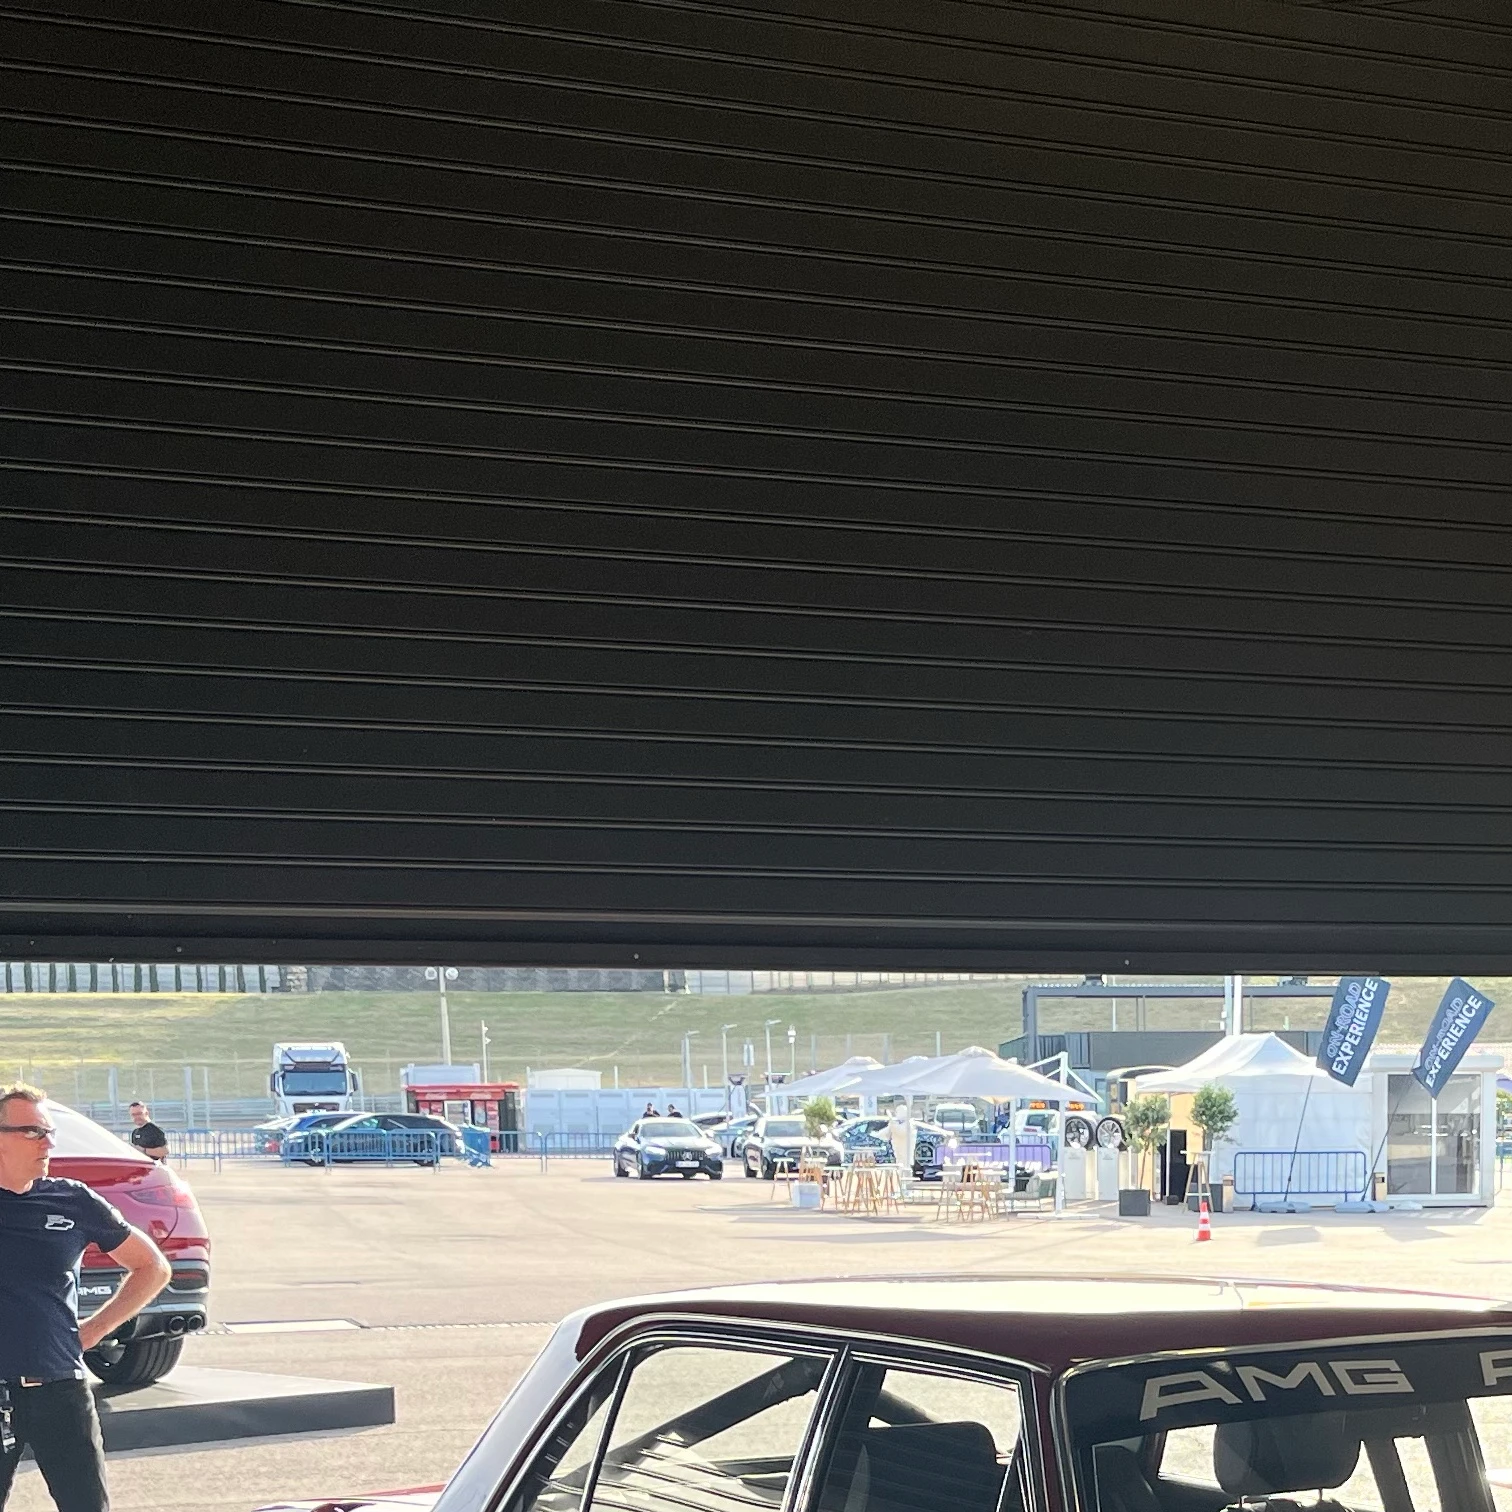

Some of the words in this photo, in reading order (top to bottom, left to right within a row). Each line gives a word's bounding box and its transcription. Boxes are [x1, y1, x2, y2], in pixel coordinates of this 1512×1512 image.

[1327, 981, 1362, 1058] ON-ROAD
[1332, 976, 1379, 1076] EXPERIENCE
[1425, 994, 1483, 1089] EXPERIENCE
[1140, 1359, 1415, 1421] AMG
